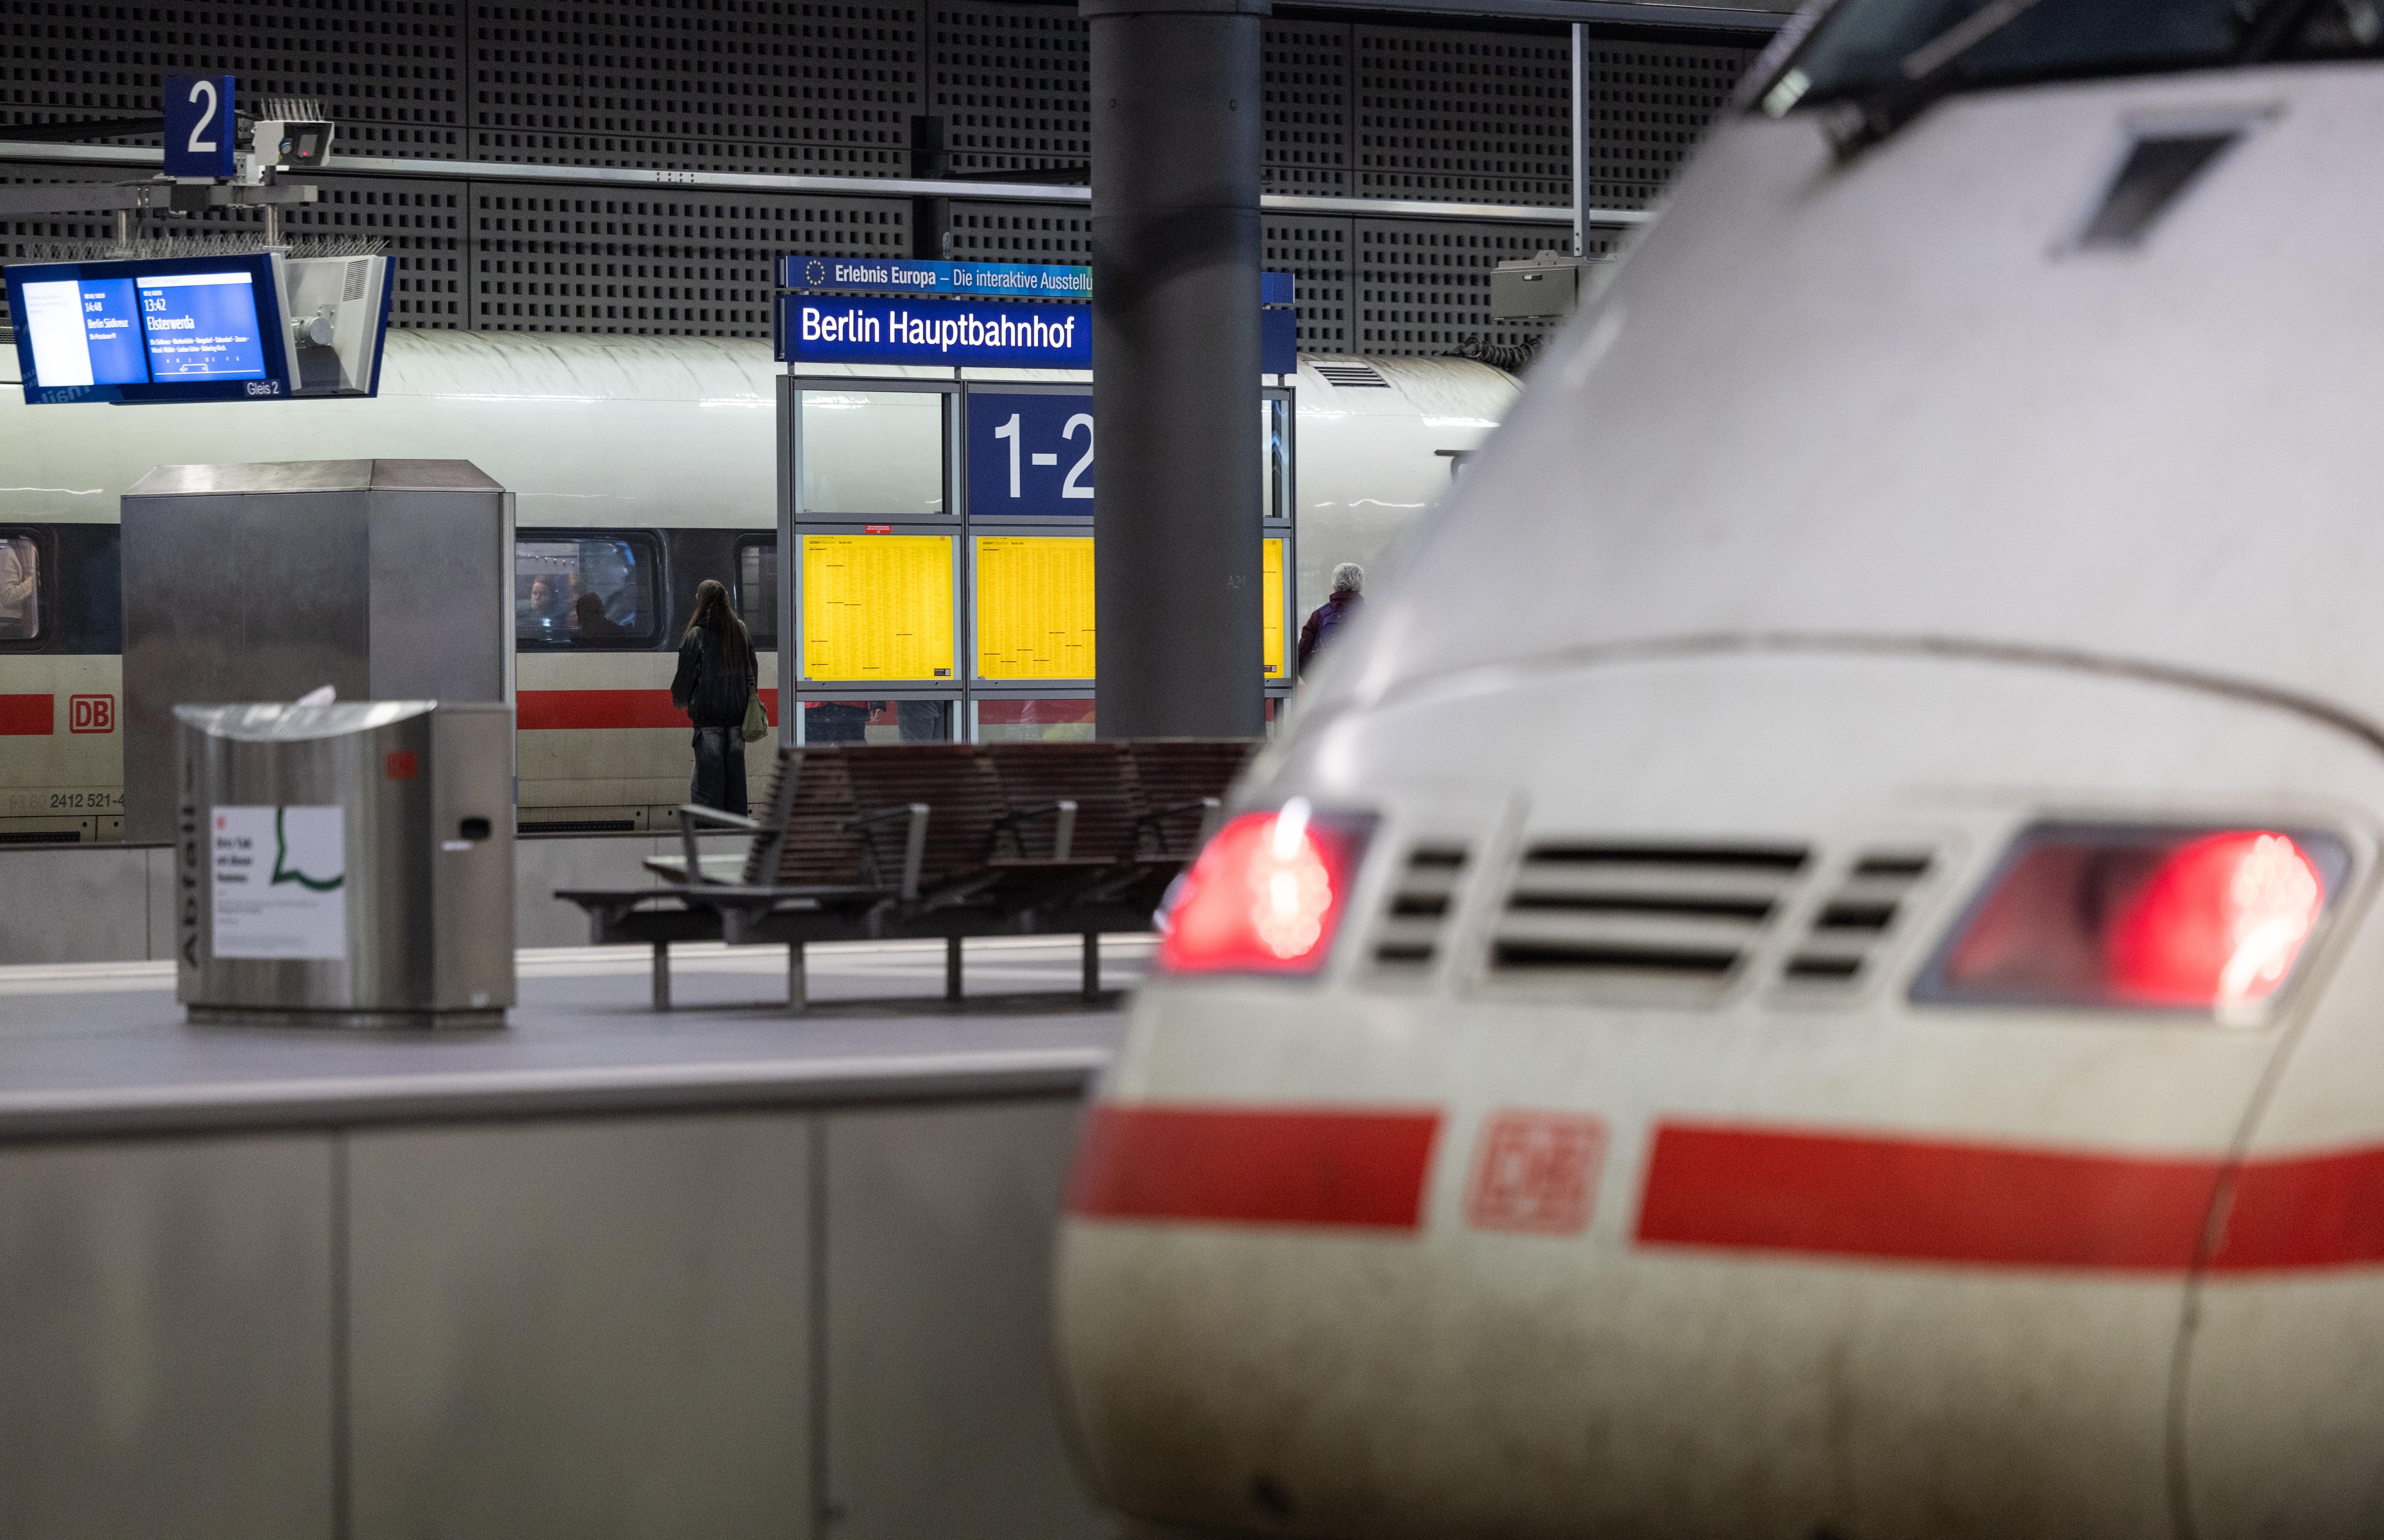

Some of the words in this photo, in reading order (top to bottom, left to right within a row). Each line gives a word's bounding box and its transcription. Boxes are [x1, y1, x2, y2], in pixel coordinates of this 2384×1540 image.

[188, 80, 217, 153] 2
[836, 265, 888, 283] Erlebnis
[892, 267, 936, 288] Europa
[954, 269, 972, 286] Die
[976, 270, 1037, 288] interaktive
[144, 298, 167, 311] 13:42
[87, 319, 104, 329] Berlin
[146, 315, 195, 331] Elsterwerda
[802, 308, 880, 342] Berlin
[890, 311, 1074, 352] Hauptbahnhof
[247, 382, 271, 395] Gleis
[271, 381, 280, 394] 2
[995, 413, 1094, 498] 1-2
[75, 700, 110, 727] DB
[50, 794, 83, 807] 2412
[87, 793, 124, 807] 521-4
